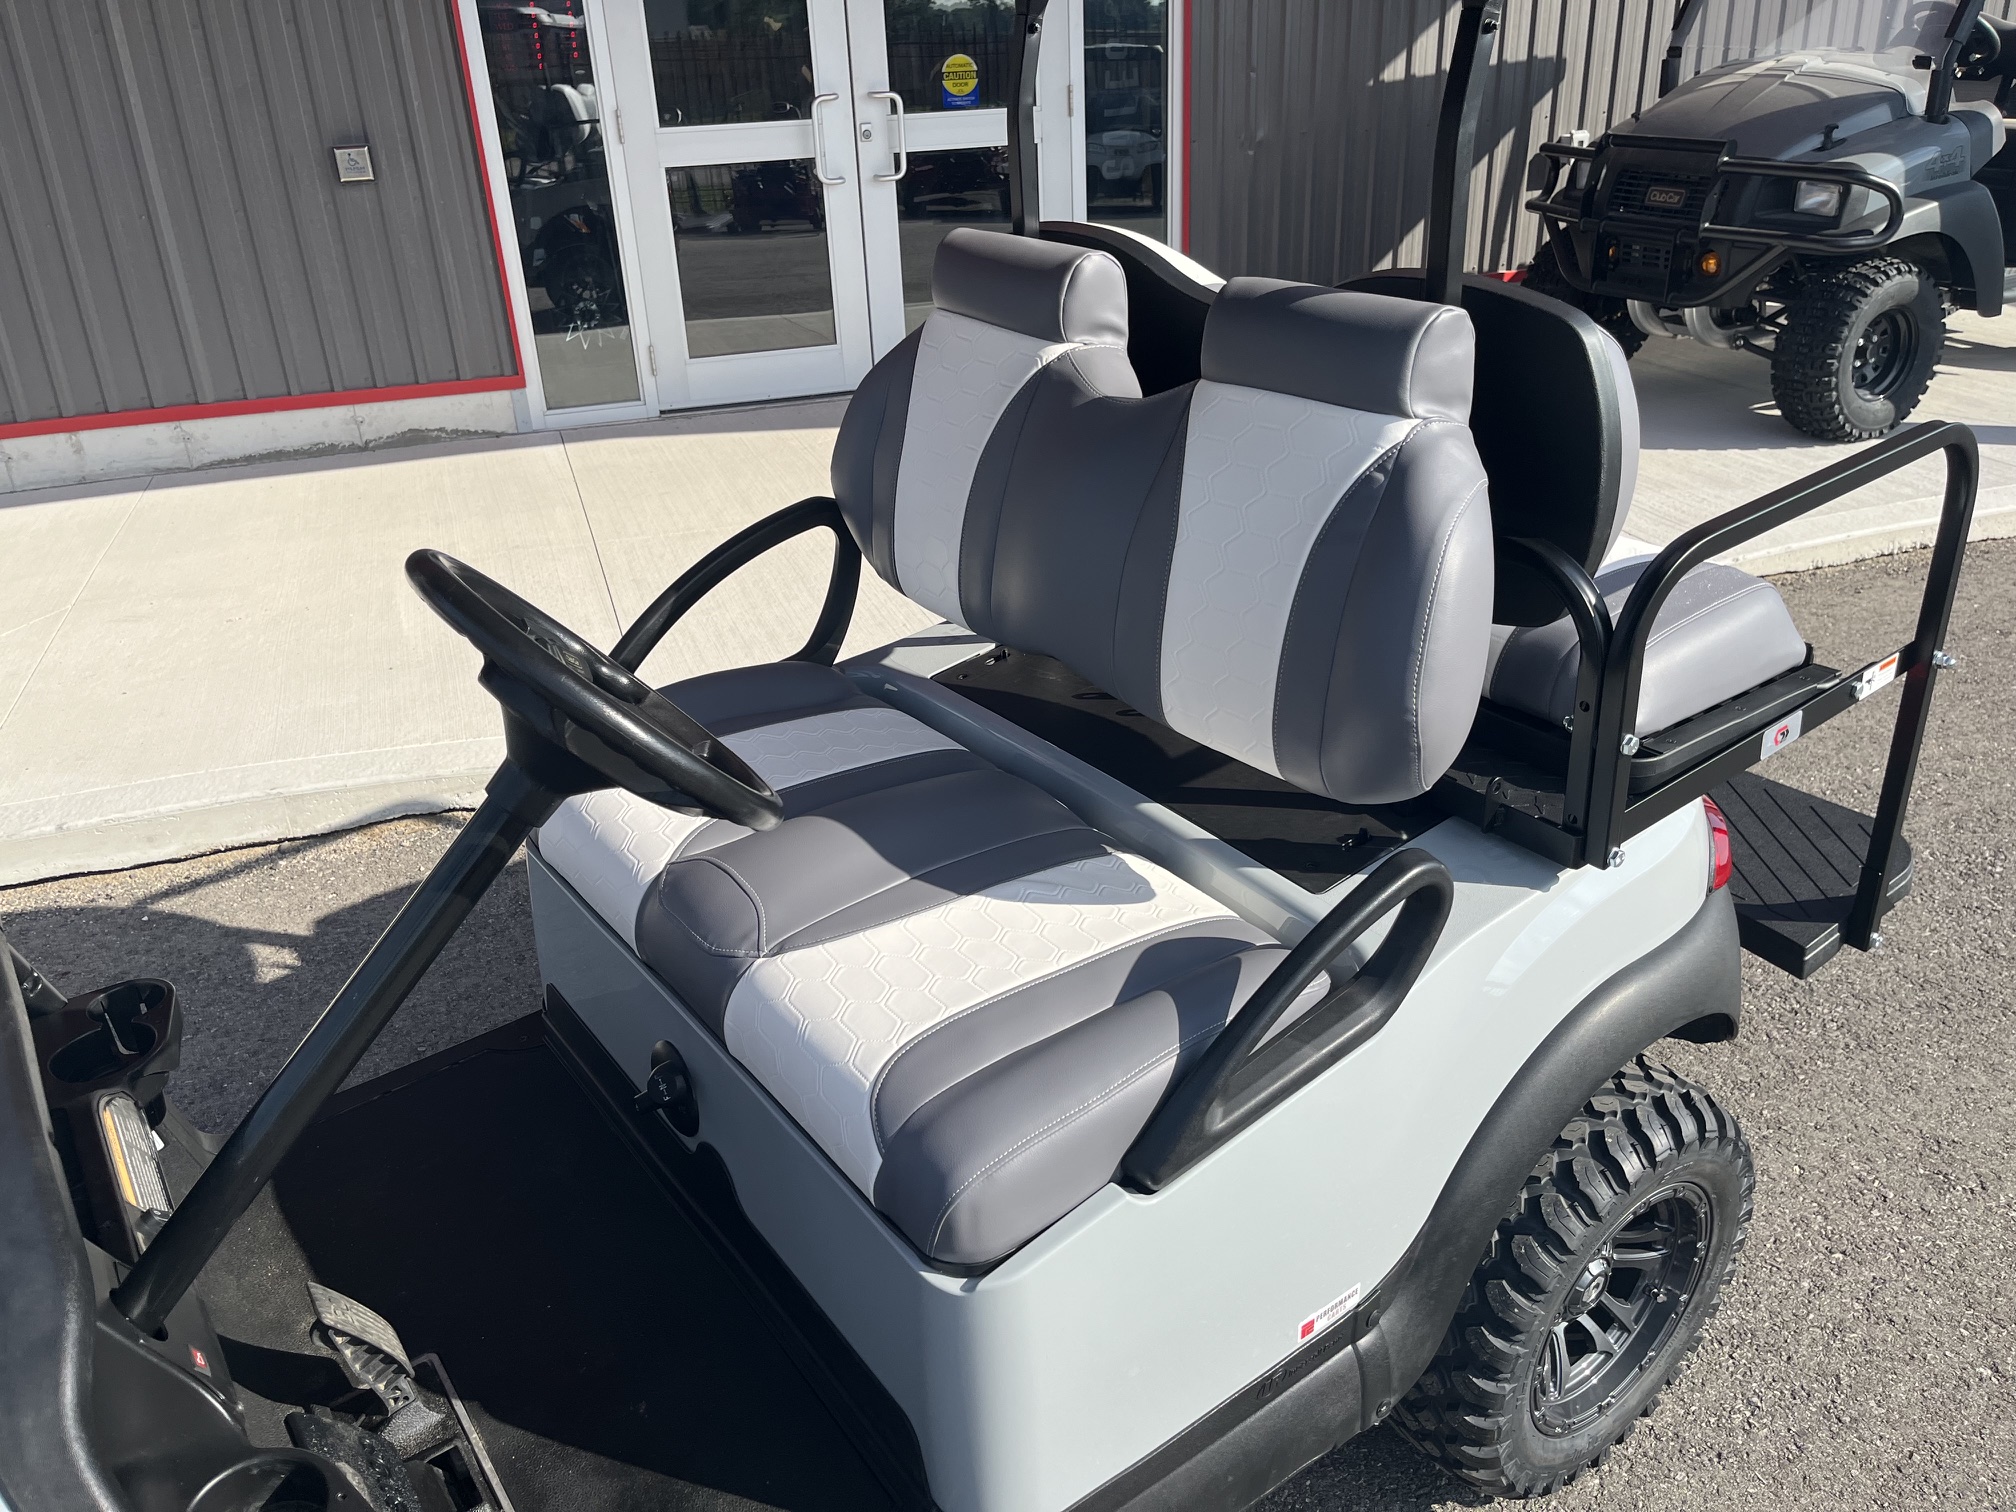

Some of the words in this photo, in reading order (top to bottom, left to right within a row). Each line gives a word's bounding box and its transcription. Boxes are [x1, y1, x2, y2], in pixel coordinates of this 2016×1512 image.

[944, 71, 976, 80] CAUTION
[1925, 145, 1966, 172] 4x4
[1650, 191, 1667, 202] Club
[1667, 193, 1680, 203] Car
[1315, 1287, 1359, 1323] PERFORMANCE
[1327, 1303, 1347, 1322] CARTS
